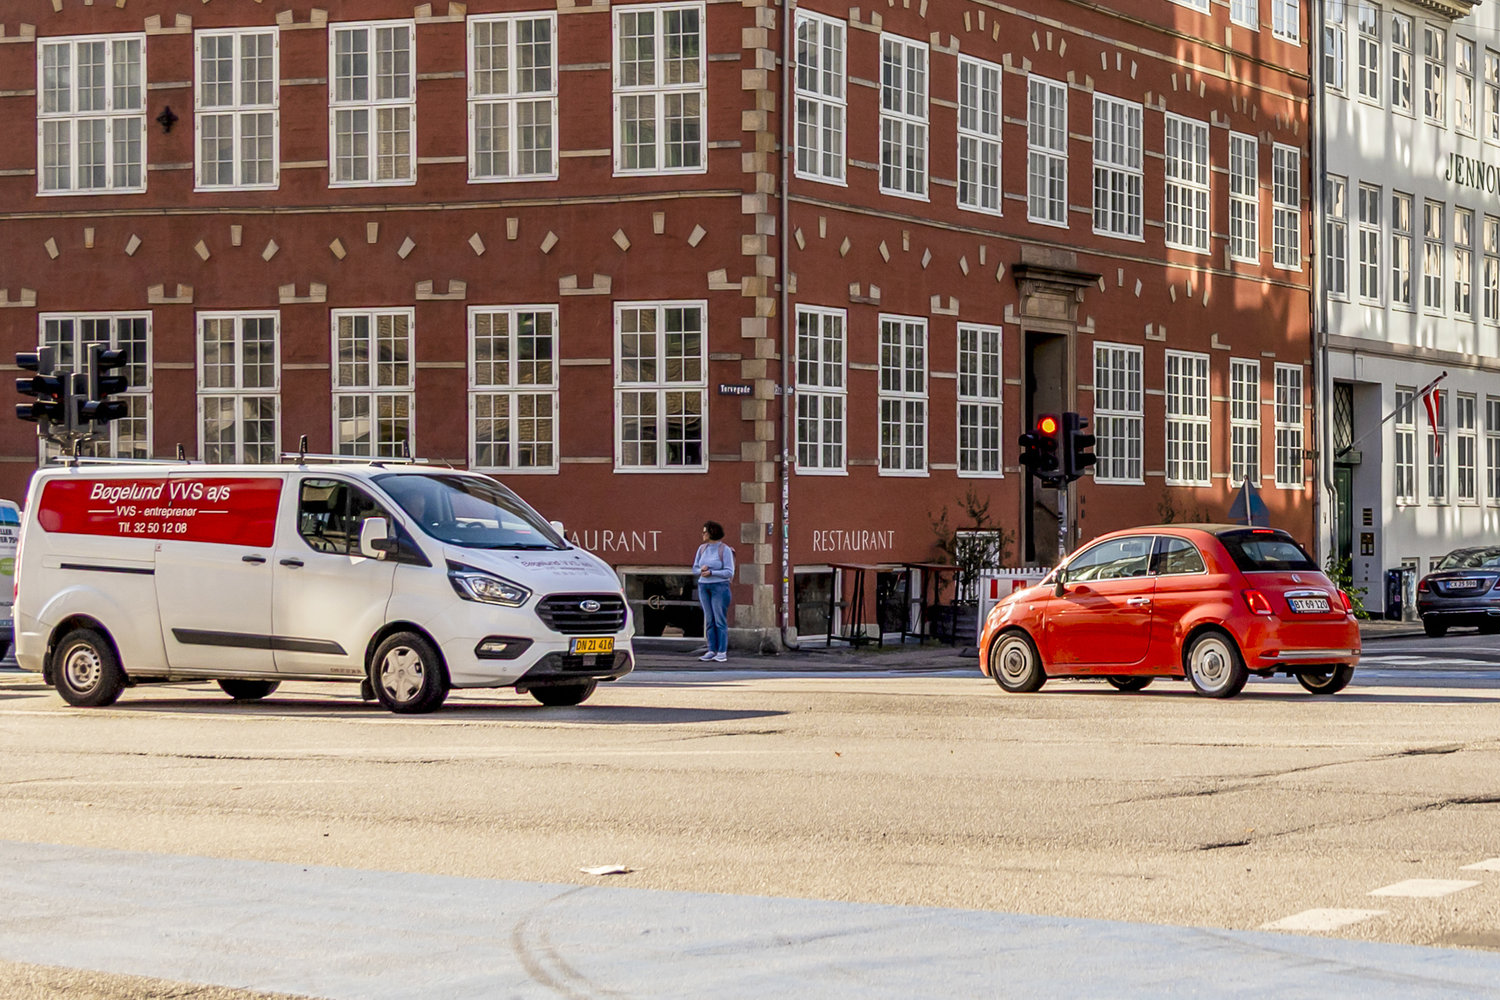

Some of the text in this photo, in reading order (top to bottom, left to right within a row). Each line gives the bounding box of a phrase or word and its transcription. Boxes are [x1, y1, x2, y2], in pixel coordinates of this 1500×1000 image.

[90, 482, 231, 504] Bøgelund VVS a/s
[116, 505, 136, 517] VVS
[143, 506, 198, 519] entreprenør
[118, 521, 188, 533] Tlf. 32 50 12 08
[812, 529, 895, 552] RESTAURANT
[1294, 600, 1328, 609] BT 69 120
[576, 639, 613, 651] DN 21 416
